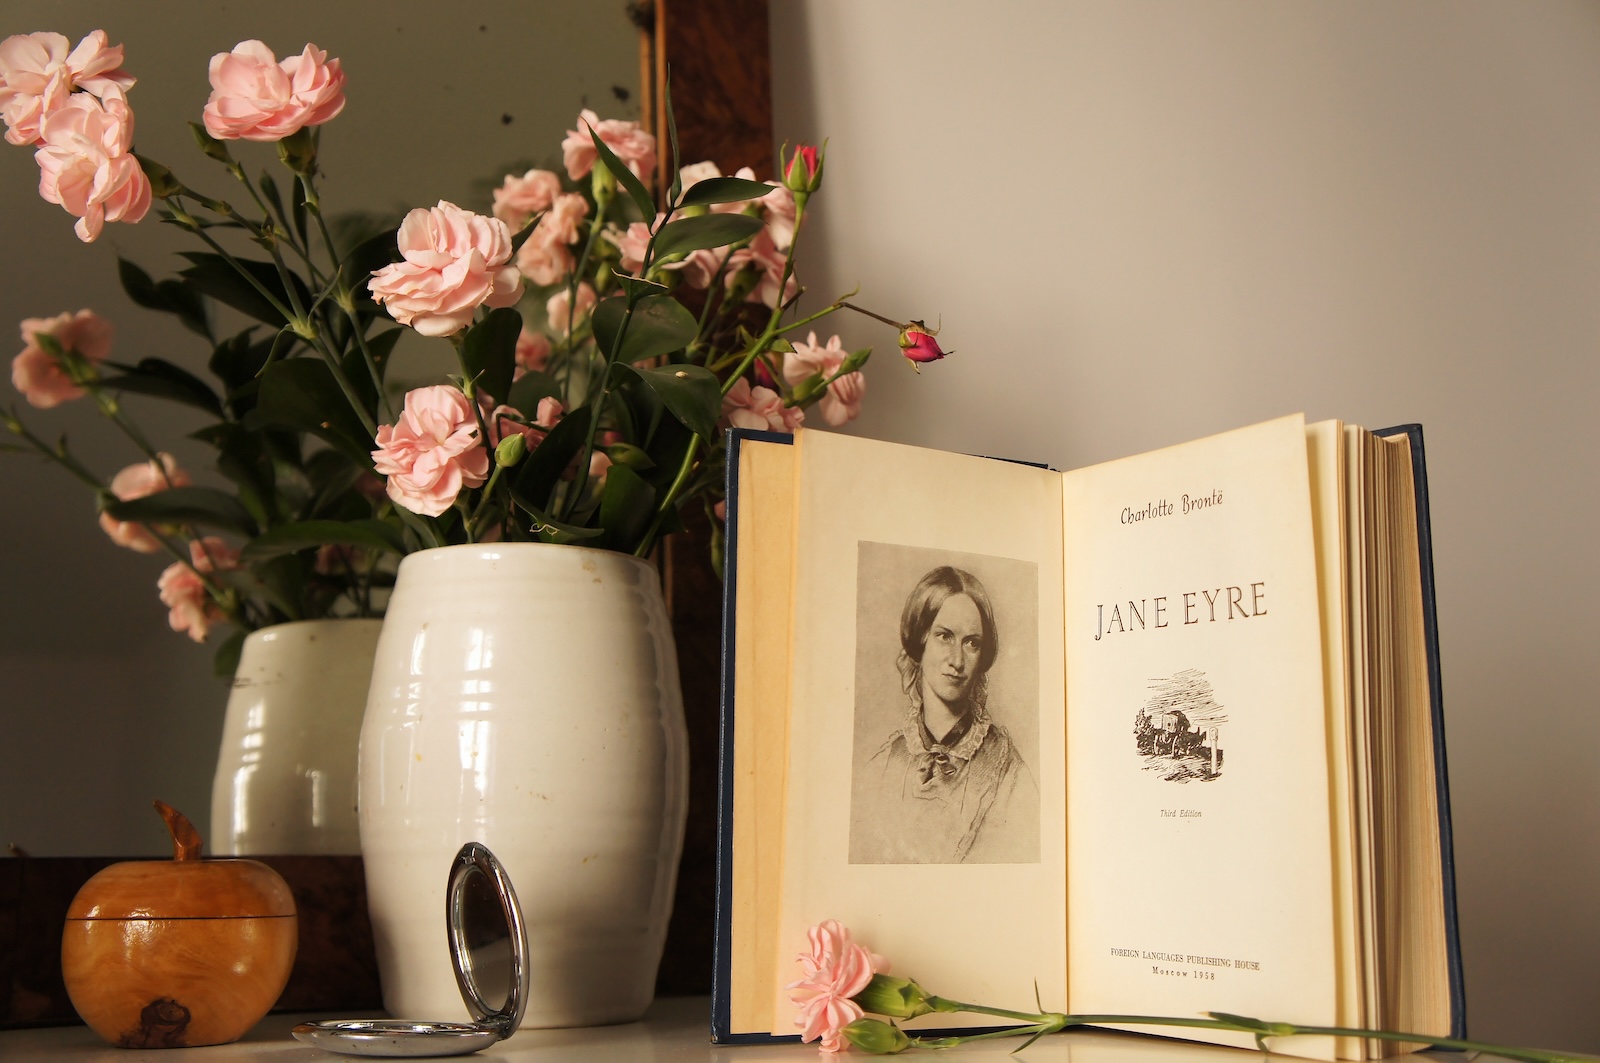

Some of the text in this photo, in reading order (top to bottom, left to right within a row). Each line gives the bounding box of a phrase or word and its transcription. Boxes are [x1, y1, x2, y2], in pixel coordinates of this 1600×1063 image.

[1121, 488, 1223, 524] Charlotte Brontë
[1094, 582, 1267, 641] JANE EYRE
[1160, 809, 1202, 818] Third Edition
[1110, 947, 1260, 971] FOREIGN LANGUAGES PUBLISHING HOUSE
[1152, 965, 1215, 981] Moscow 1958
